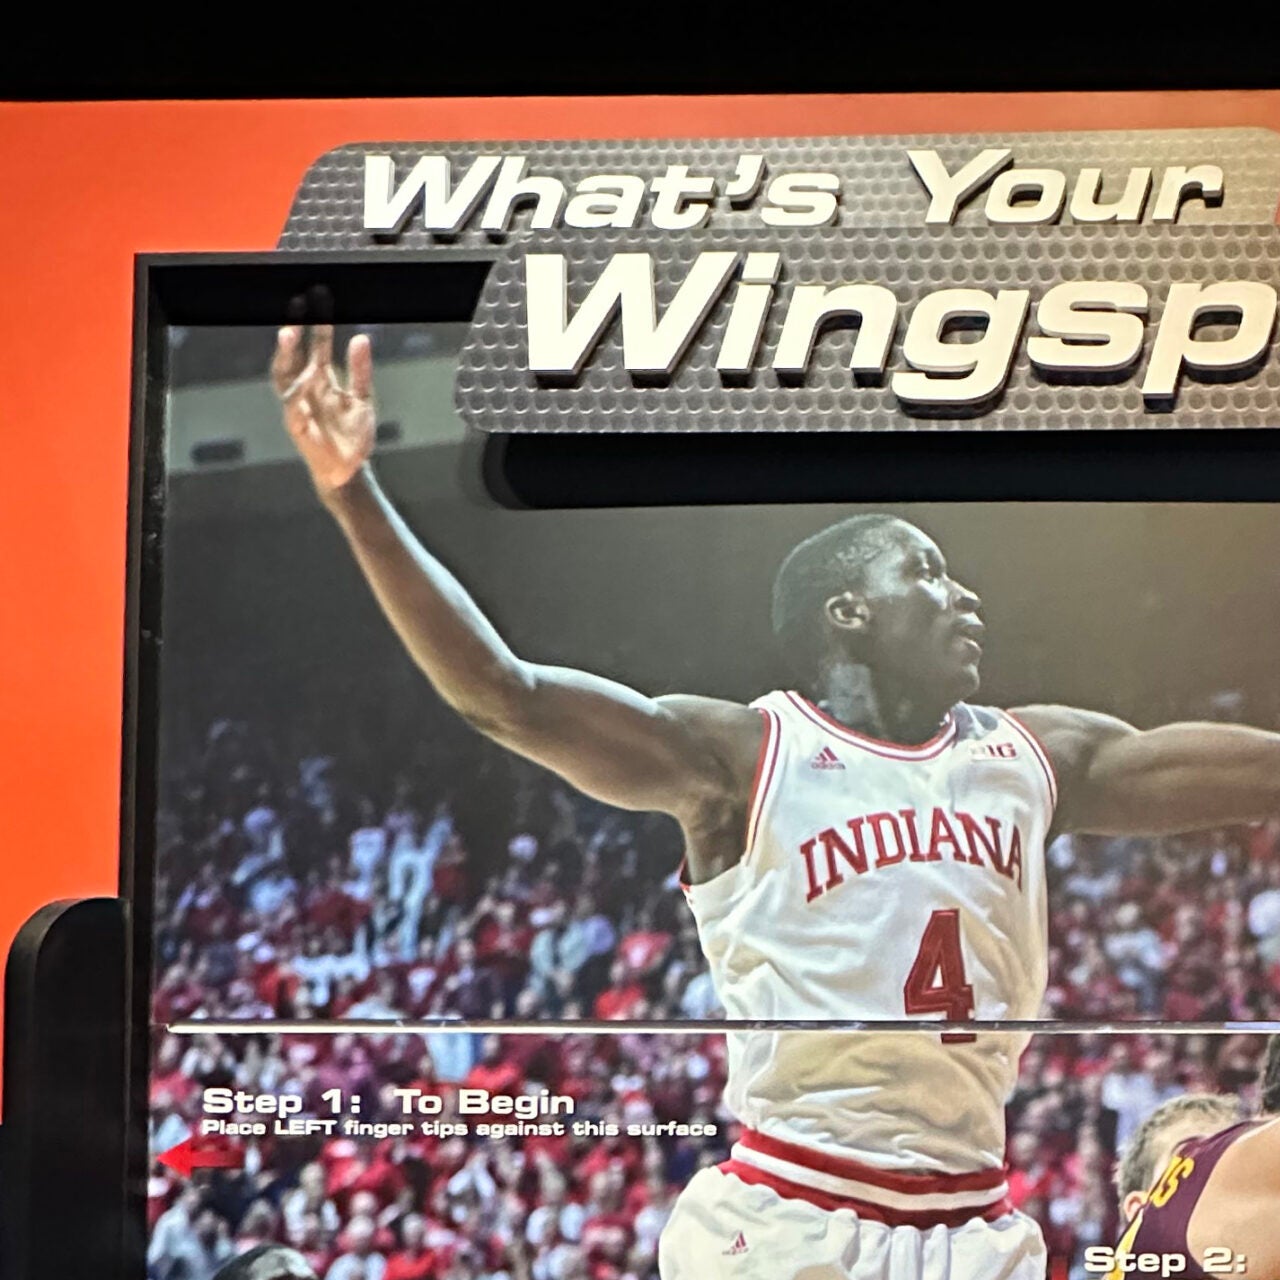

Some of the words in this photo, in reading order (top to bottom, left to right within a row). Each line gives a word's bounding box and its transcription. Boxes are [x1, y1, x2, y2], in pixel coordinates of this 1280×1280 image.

[362, 153, 841, 236] What's
[906, 148, 1224, 228] Your
[799, 806, 1024, 904] INDIANA
[903, 907, 978, 1045] 4
[202, 1087, 302, 1118] Step
[321, 1089, 362, 1115] 1:
[394, 1089, 442, 1115] To
[458, 1088, 575, 1118] Begin
[202, 1119, 266, 1136] Place
[273, 1119, 338, 1135] LEFT
[343, 1119, 415, 1138] finger
[421, 1119, 469, 1138] tips
[475, 1120, 567, 1139] against
[572, 1119, 621, 1137] this
[625, 1120, 718, 1138] surface
[1083, 1246, 1187, 1278] Step
[1202, 1247, 1249, 1273] 2:
